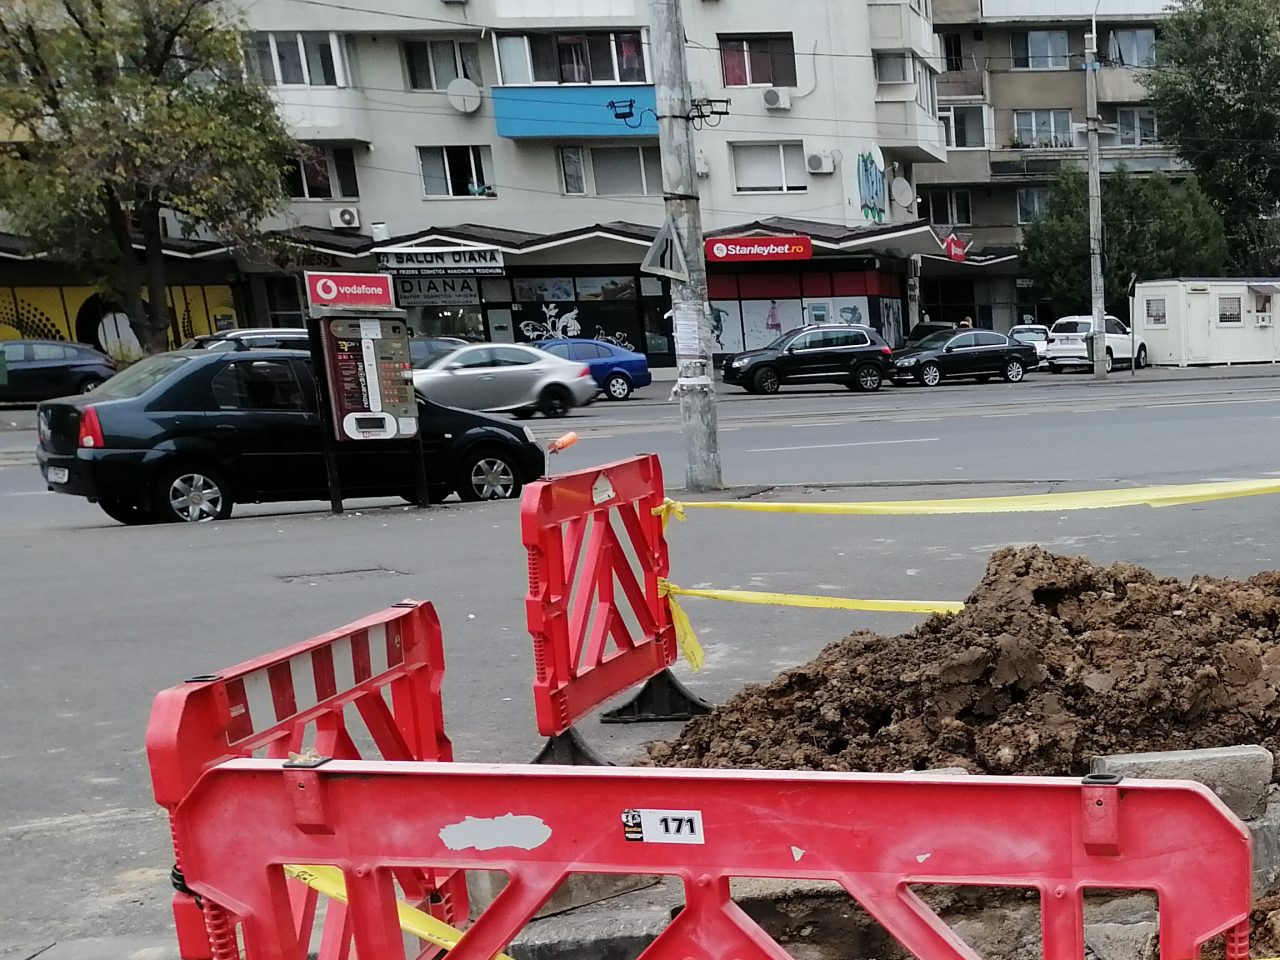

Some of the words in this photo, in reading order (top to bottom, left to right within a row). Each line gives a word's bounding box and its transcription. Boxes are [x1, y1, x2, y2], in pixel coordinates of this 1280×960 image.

[728, 243, 804, 256] Stanleybet.ro
[396, 253, 445, 264] SALON
[452, 251, 498, 263] DIANA
[339, 284, 383, 295] vodafone
[401, 279, 473, 293] DIANA
[659, 816, 696, 835] 171
